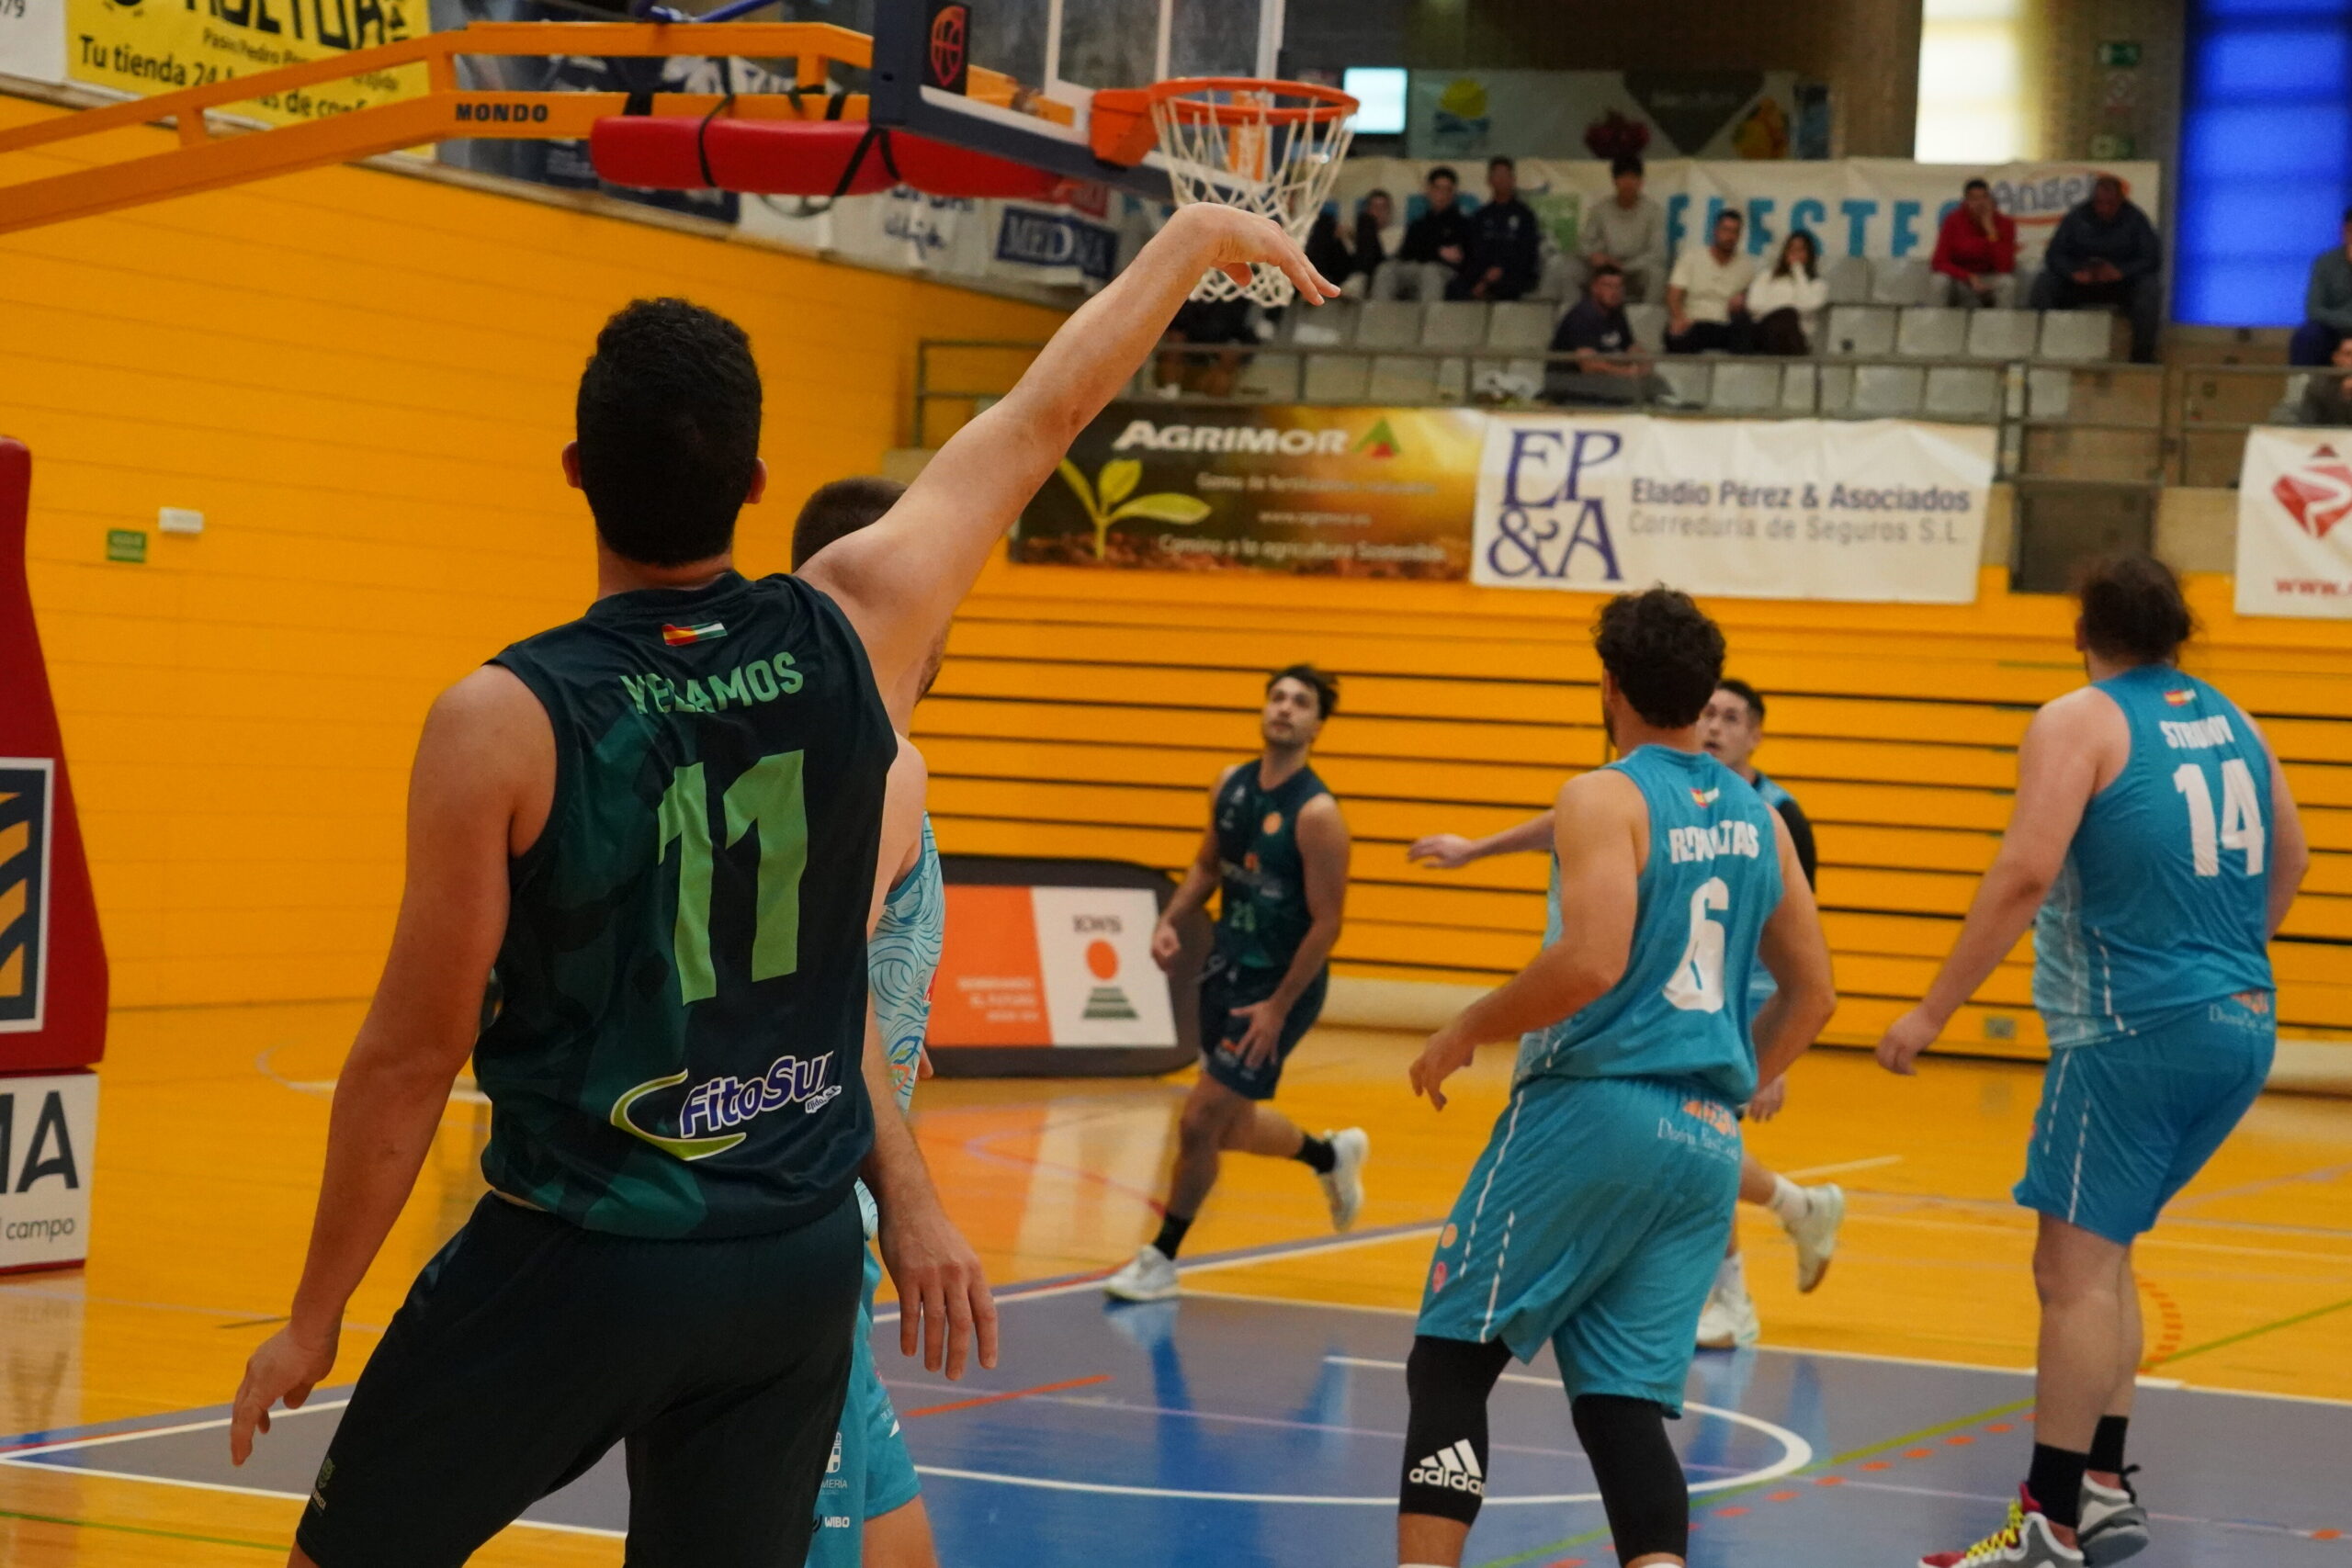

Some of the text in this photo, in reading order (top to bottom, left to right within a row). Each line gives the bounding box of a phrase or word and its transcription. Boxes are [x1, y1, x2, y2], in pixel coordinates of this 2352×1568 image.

[79, 34, 107, 68] Tu
[113, 45, 187, 85] tienda
[455, 102, 548, 122] MONDO
[1113, 420, 1349, 455] AGRIMOR
[1631, 478, 1971, 513] Eladio Pérez & Asociados
[1765, 515, 1796, 540] de
[1806, 514, 1908, 545] Seguros
[2173, 759, 2266, 877] 14
[657, 749, 808, 1007] 11
[1661, 875, 1729, 1014] 6
[6, 1216, 75, 1242] campo
[824, 1516, 851, 1529] WIBO
